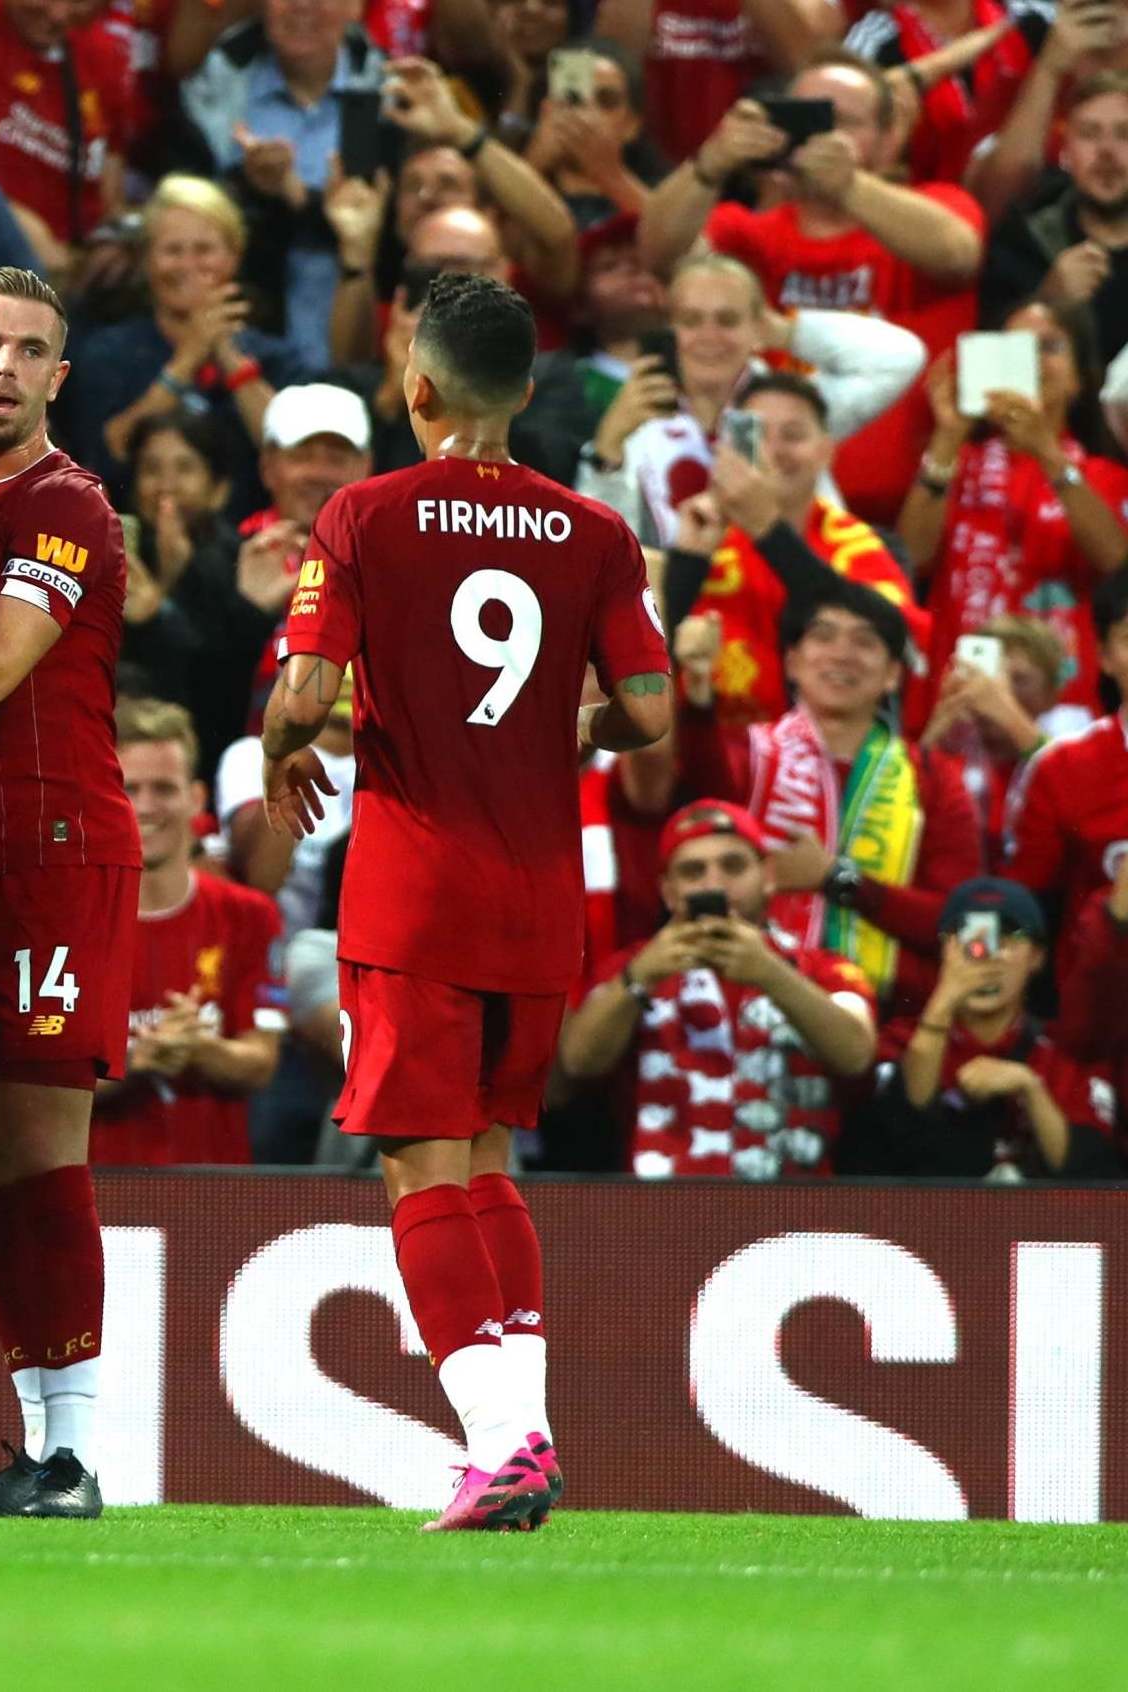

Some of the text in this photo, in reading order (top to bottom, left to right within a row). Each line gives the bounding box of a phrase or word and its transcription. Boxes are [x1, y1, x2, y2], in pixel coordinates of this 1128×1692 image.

[417, 500, 572, 543] FIRMINO
[36, 533, 89, 573] WU
[17, 562, 78, 603] Captain
[450, 568, 543, 727] 9
[13, 946, 80, 1013] 14
